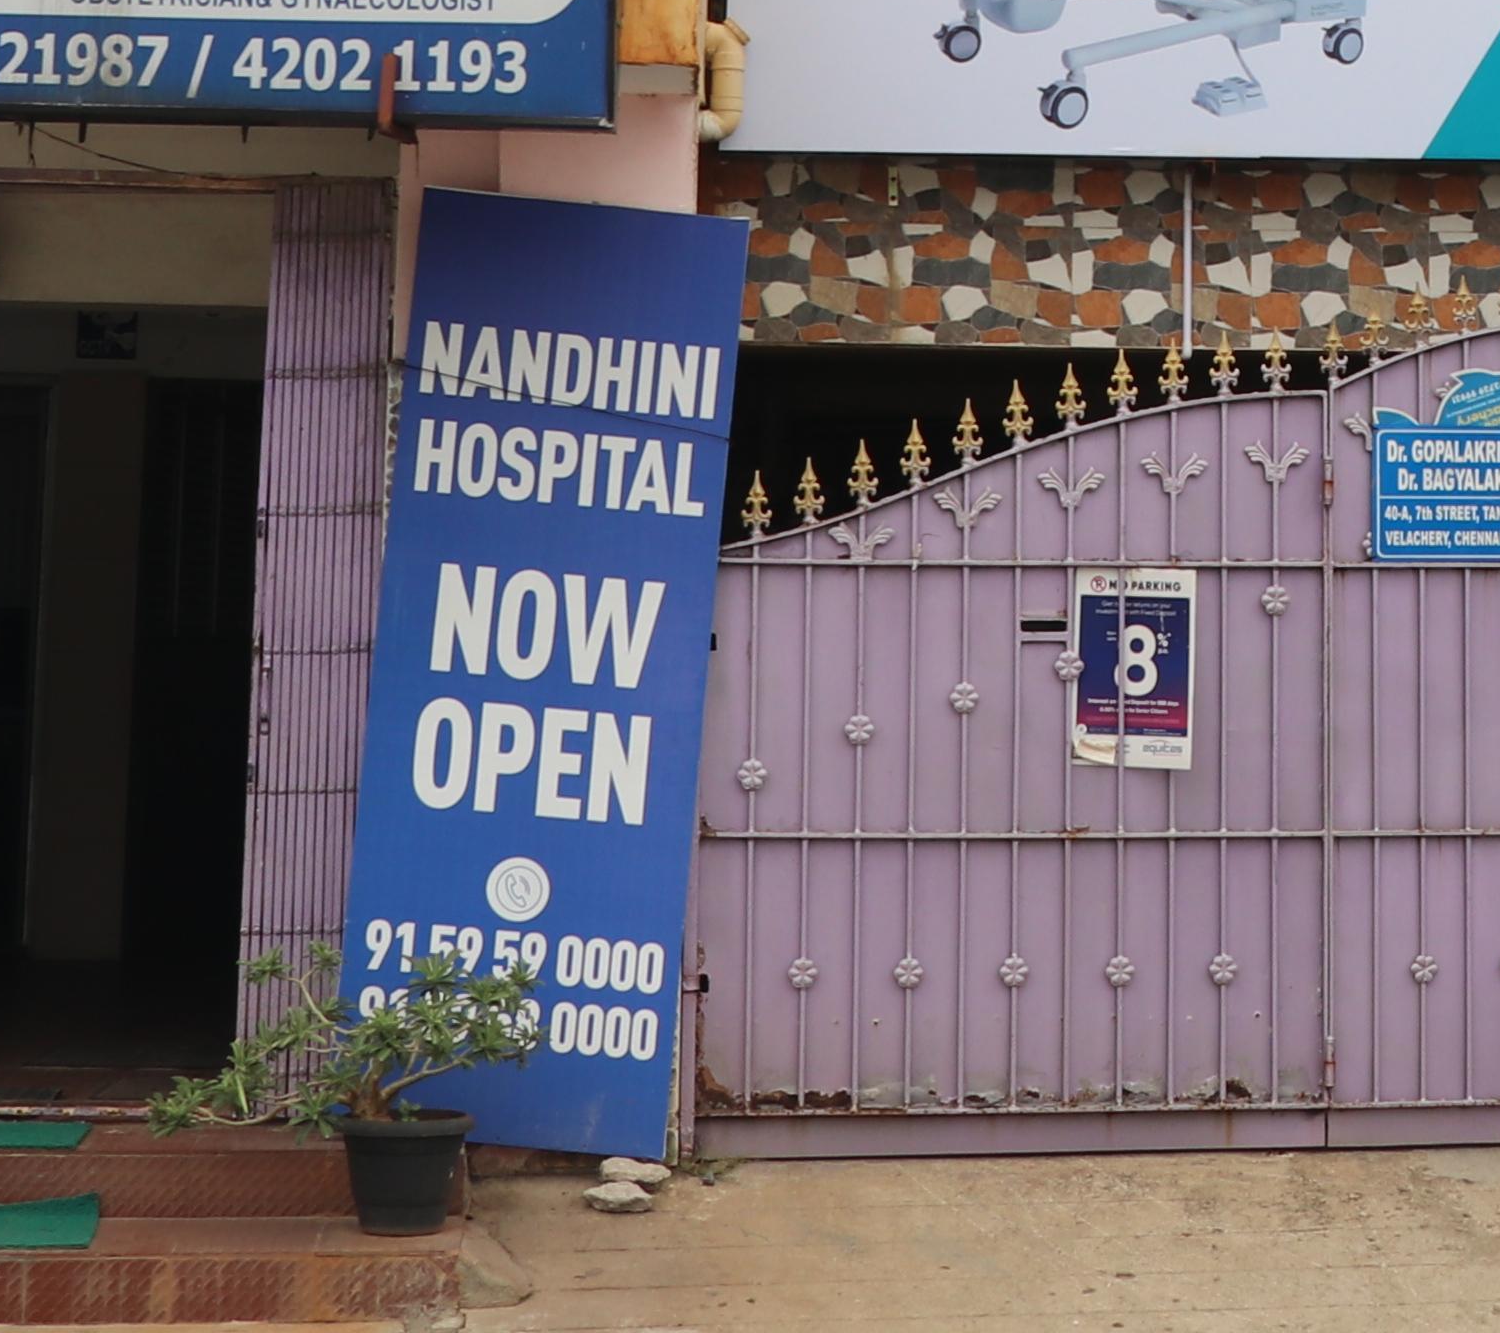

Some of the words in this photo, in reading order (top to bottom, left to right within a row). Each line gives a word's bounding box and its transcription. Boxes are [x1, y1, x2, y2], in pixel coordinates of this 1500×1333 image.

[232, 37, 371, 92] 4202
[397, 39, 528, 95] 1193
[419, 321, 721, 421] NANDHINI
[413, 418, 704, 518] HOSPITAL
[1387, 440, 1407, 462] Dr.
[1397, 468, 1418, 491] Dr.
[1384, 505, 1412, 523] 40-A,
[1415, 505, 1433, 521] 7th
[1436, 505, 1480, 523] STREET,
[1386, 530, 1451, 548] VELACHERY,
[1131, 581, 1182, 592] PARKING
[429, 562, 666, 690] NOW
[1114, 624, 1157, 696] 8
[412, 696, 652, 827] OPEN
[364, 918, 416, 974] 91
[556, 935, 665, 995] 0000
